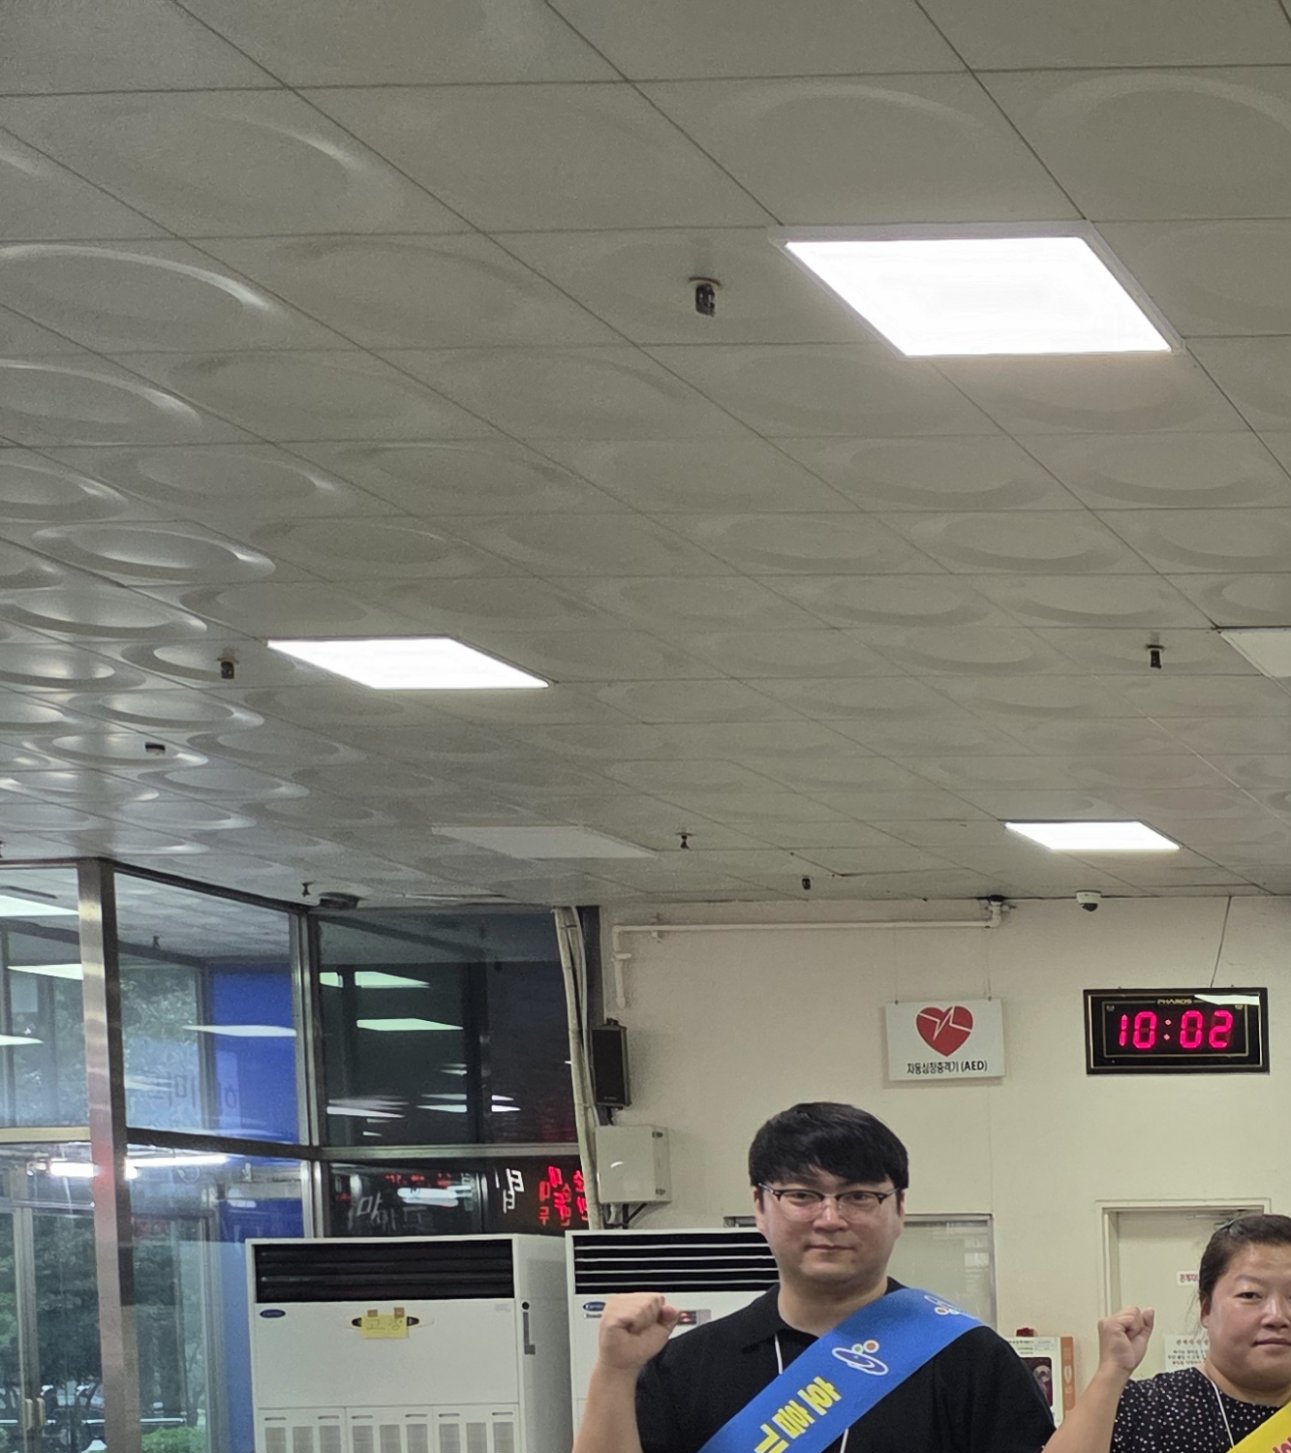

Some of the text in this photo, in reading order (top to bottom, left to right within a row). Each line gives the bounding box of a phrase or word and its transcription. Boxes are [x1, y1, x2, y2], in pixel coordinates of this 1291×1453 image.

[1119, 1010, 1234, 1049] 10:02
[906, 1060, 988, 1075] 자동심장충격기 (AED)
